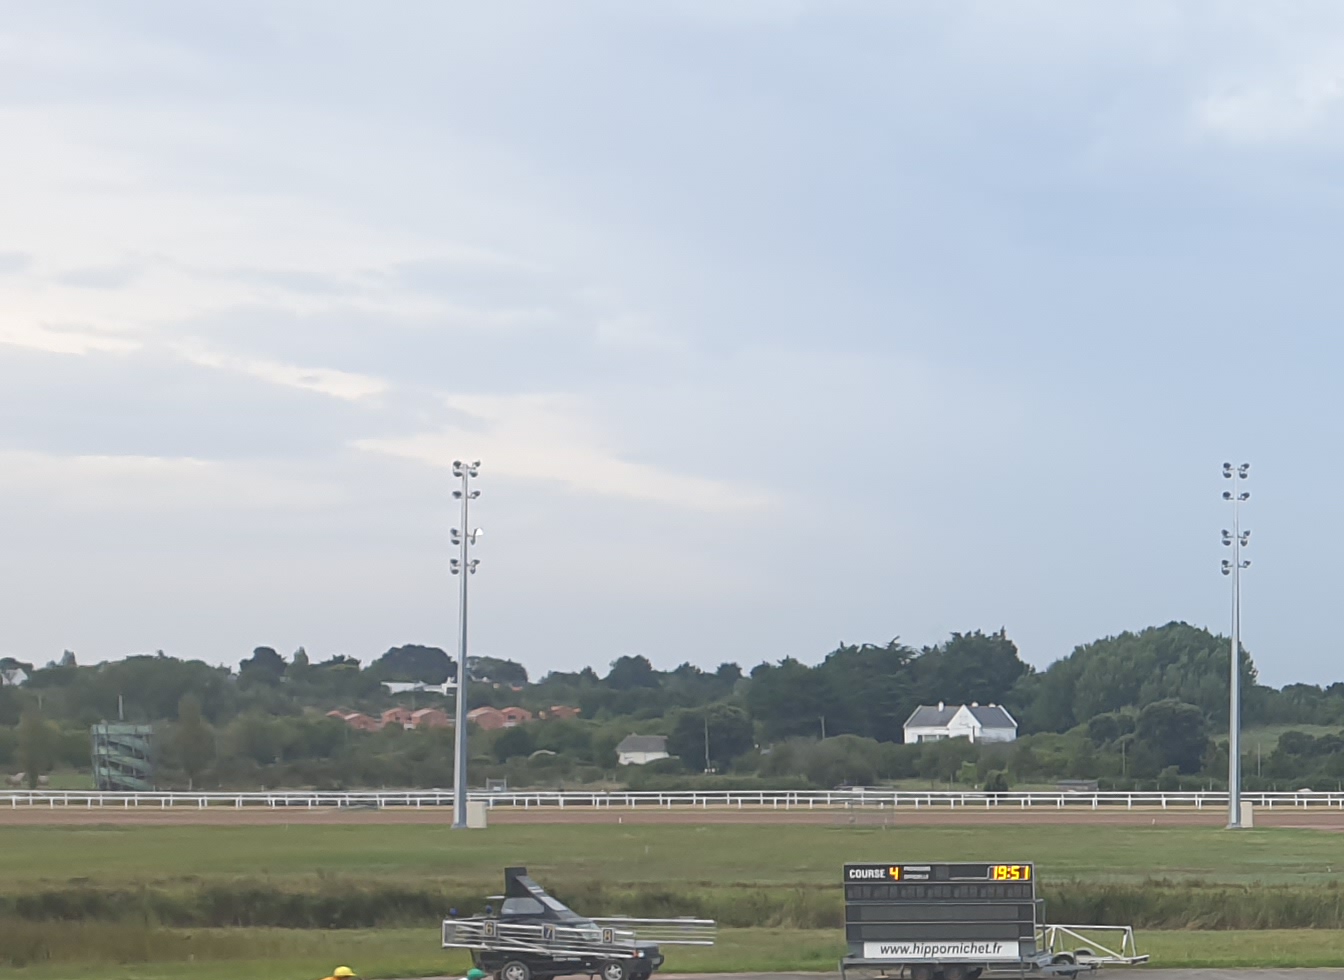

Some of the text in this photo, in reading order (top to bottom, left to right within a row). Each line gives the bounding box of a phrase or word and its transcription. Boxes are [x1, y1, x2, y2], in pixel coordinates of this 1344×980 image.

[849, 869, 886, 879] COURSE
[889, 866, 900, 881] 4
[992, 866, 1030, 880] 19:51
[880, 942, 1003, 958] www.hippornichet.fr
